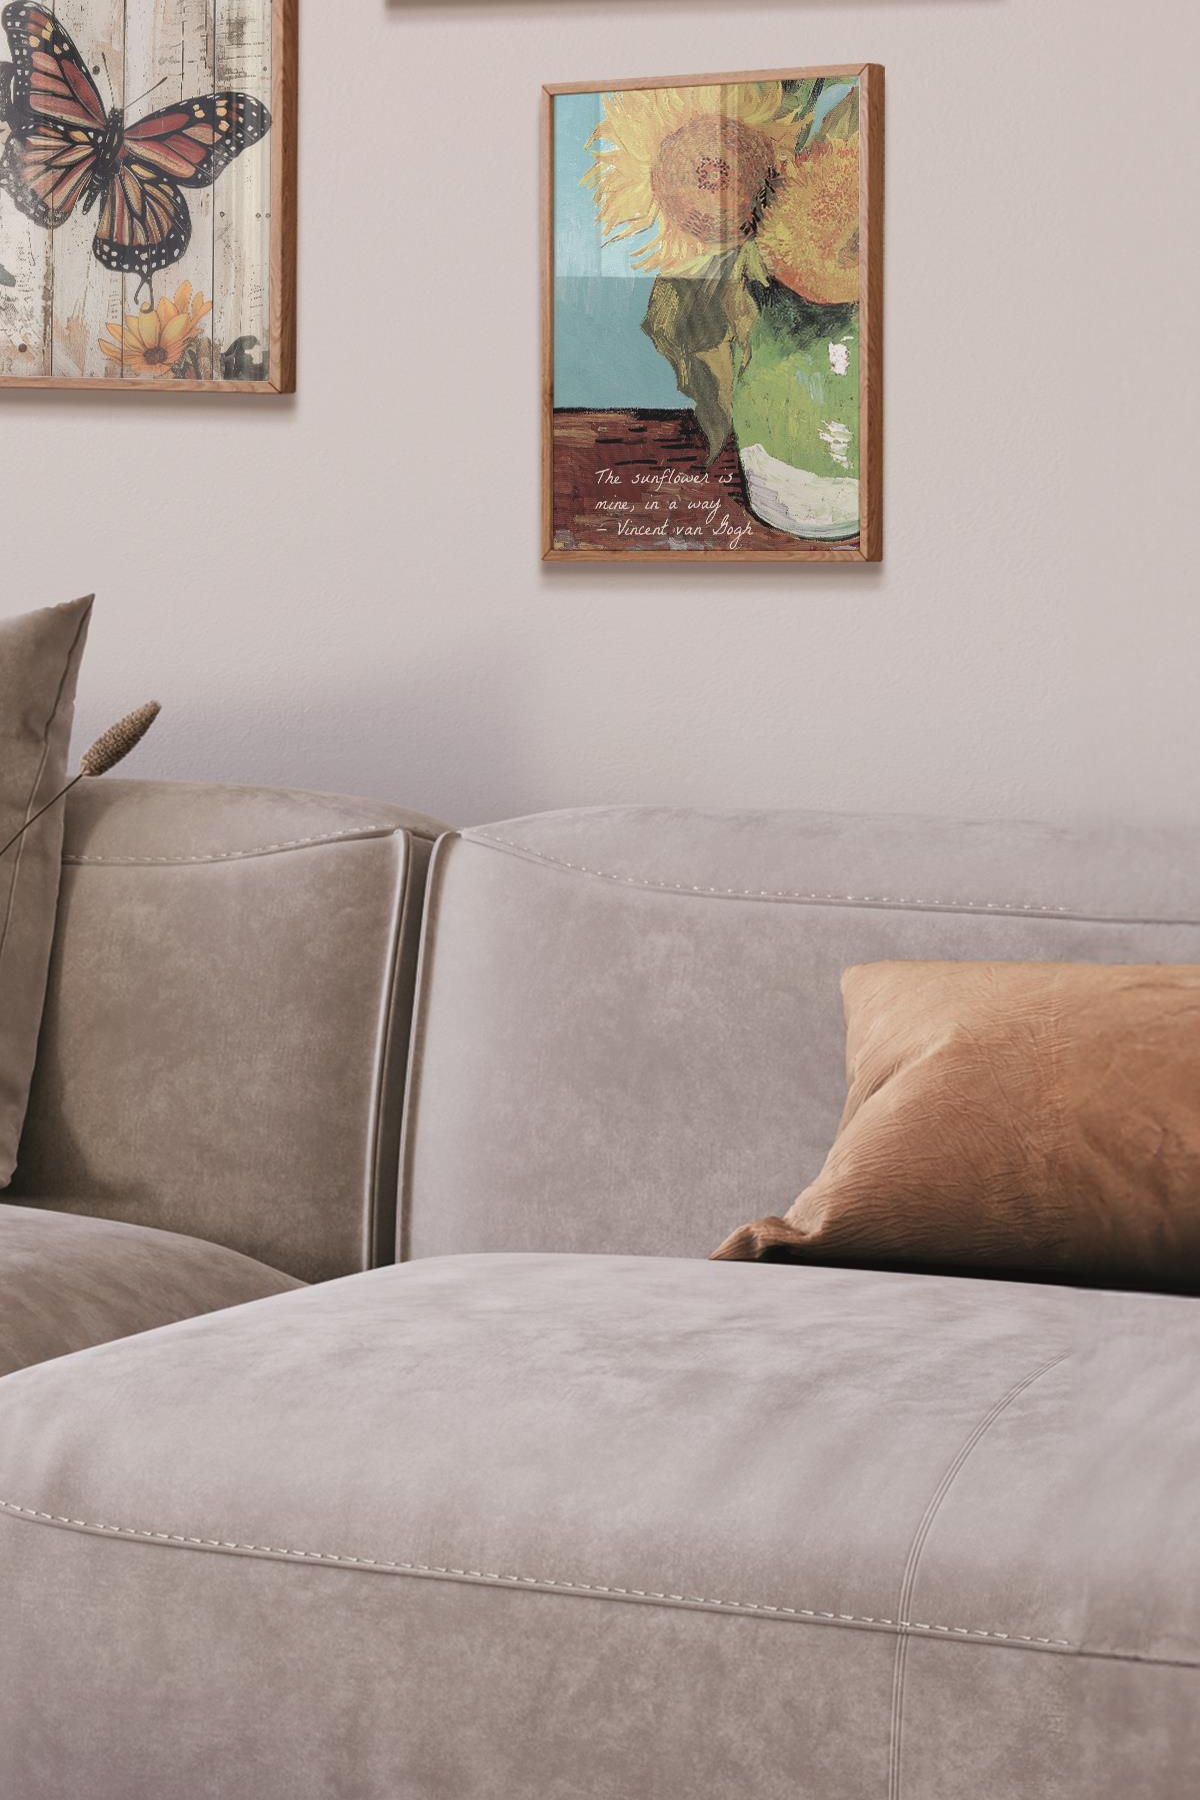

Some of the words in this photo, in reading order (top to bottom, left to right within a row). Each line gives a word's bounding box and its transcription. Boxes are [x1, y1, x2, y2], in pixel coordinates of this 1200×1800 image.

[595, 467, 622, 485] The
[631, 467, 710, 491] sunflower
[718, 468, 733, 485] is
[595, 494, 635, 512] mine,
[644, 494, 660, 511] in
[668, 499, 678, 510] a
[687, 500, 722, 525] way
[616, 518, 669, 537] Vincent
[675, 523, 703, 537] van
[712, 512, 754, 550] Gogh
